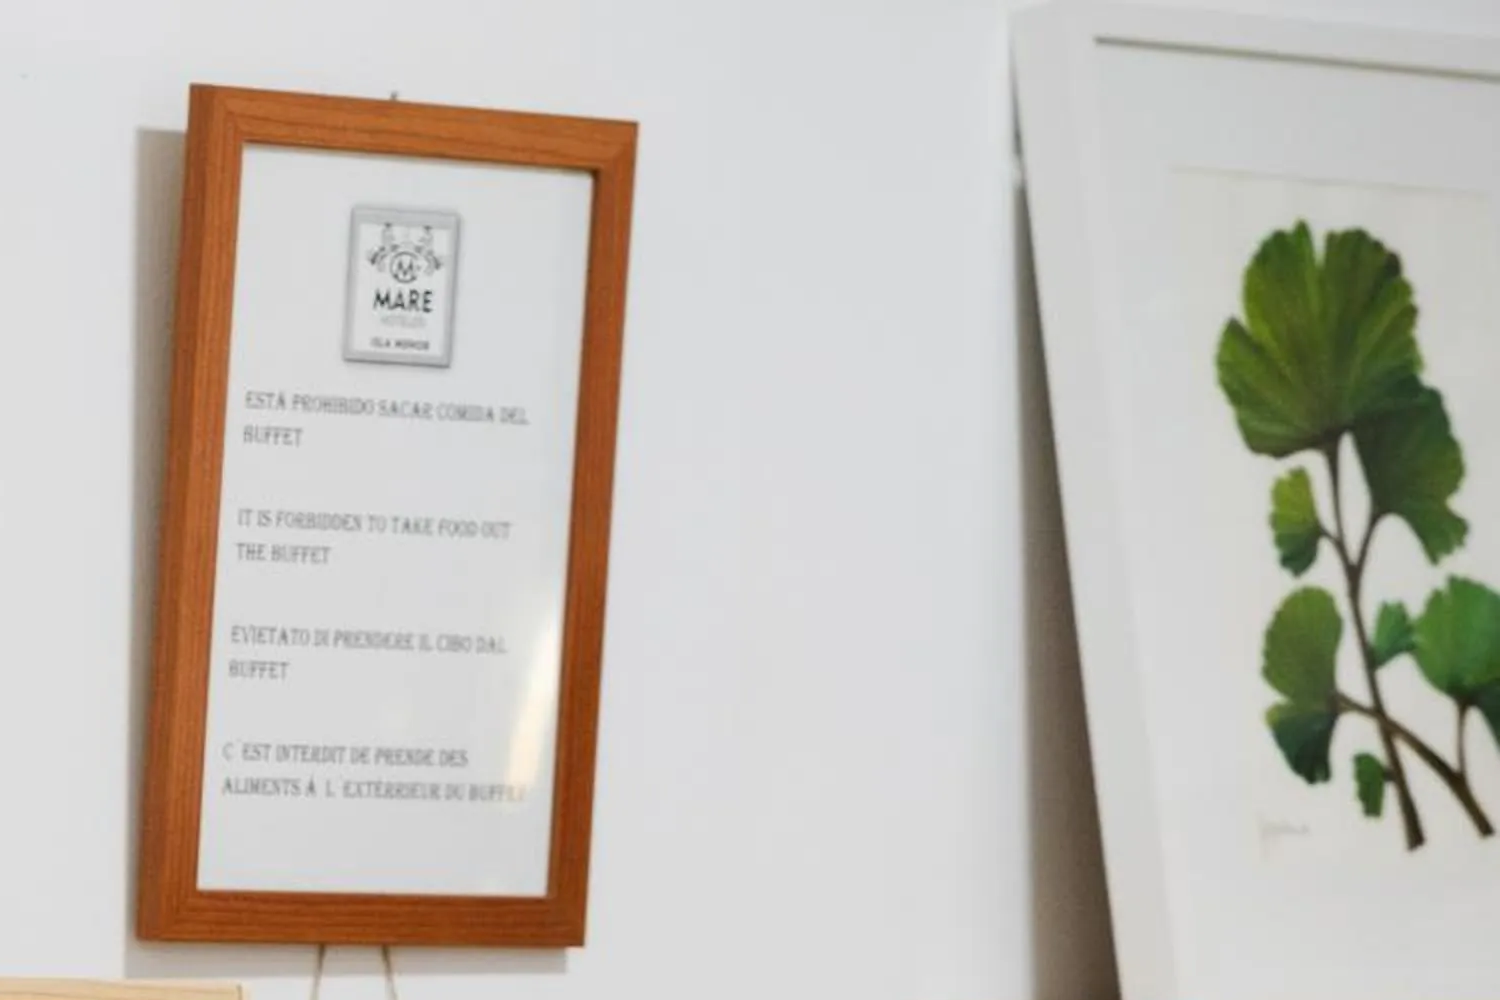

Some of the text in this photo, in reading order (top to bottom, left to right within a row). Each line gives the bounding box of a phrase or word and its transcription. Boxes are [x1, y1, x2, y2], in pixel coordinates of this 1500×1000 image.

[373, 287, 433, 313] MARE
[292, 394, 375, 416] PROHIBIDO
[378, 399, 433, 420] SACAR
[437, 402, 494, 423] COMIDA
[499, 405, 530, 425] DEL
[243, 425, 303, 447] BUFFET
[237, 508, 514, 540] IT IS FORBIDDEN TO TAKE FOOD OUT
[236, 542, 331, 565] THE BUFFET
[333, 629, 415, 651] PRENDERE
[436, 633, 472, 653] CIBO
[476, 635, 508, 654] DAL
[228, 659, 289, 681] BUFFET
[276, 744, 347, 766] INTERDIT
[350, 746, 370, 766] DE
[438, 748, 469, 768] DES
[222, 777, 301, 797] ALIMENTS
